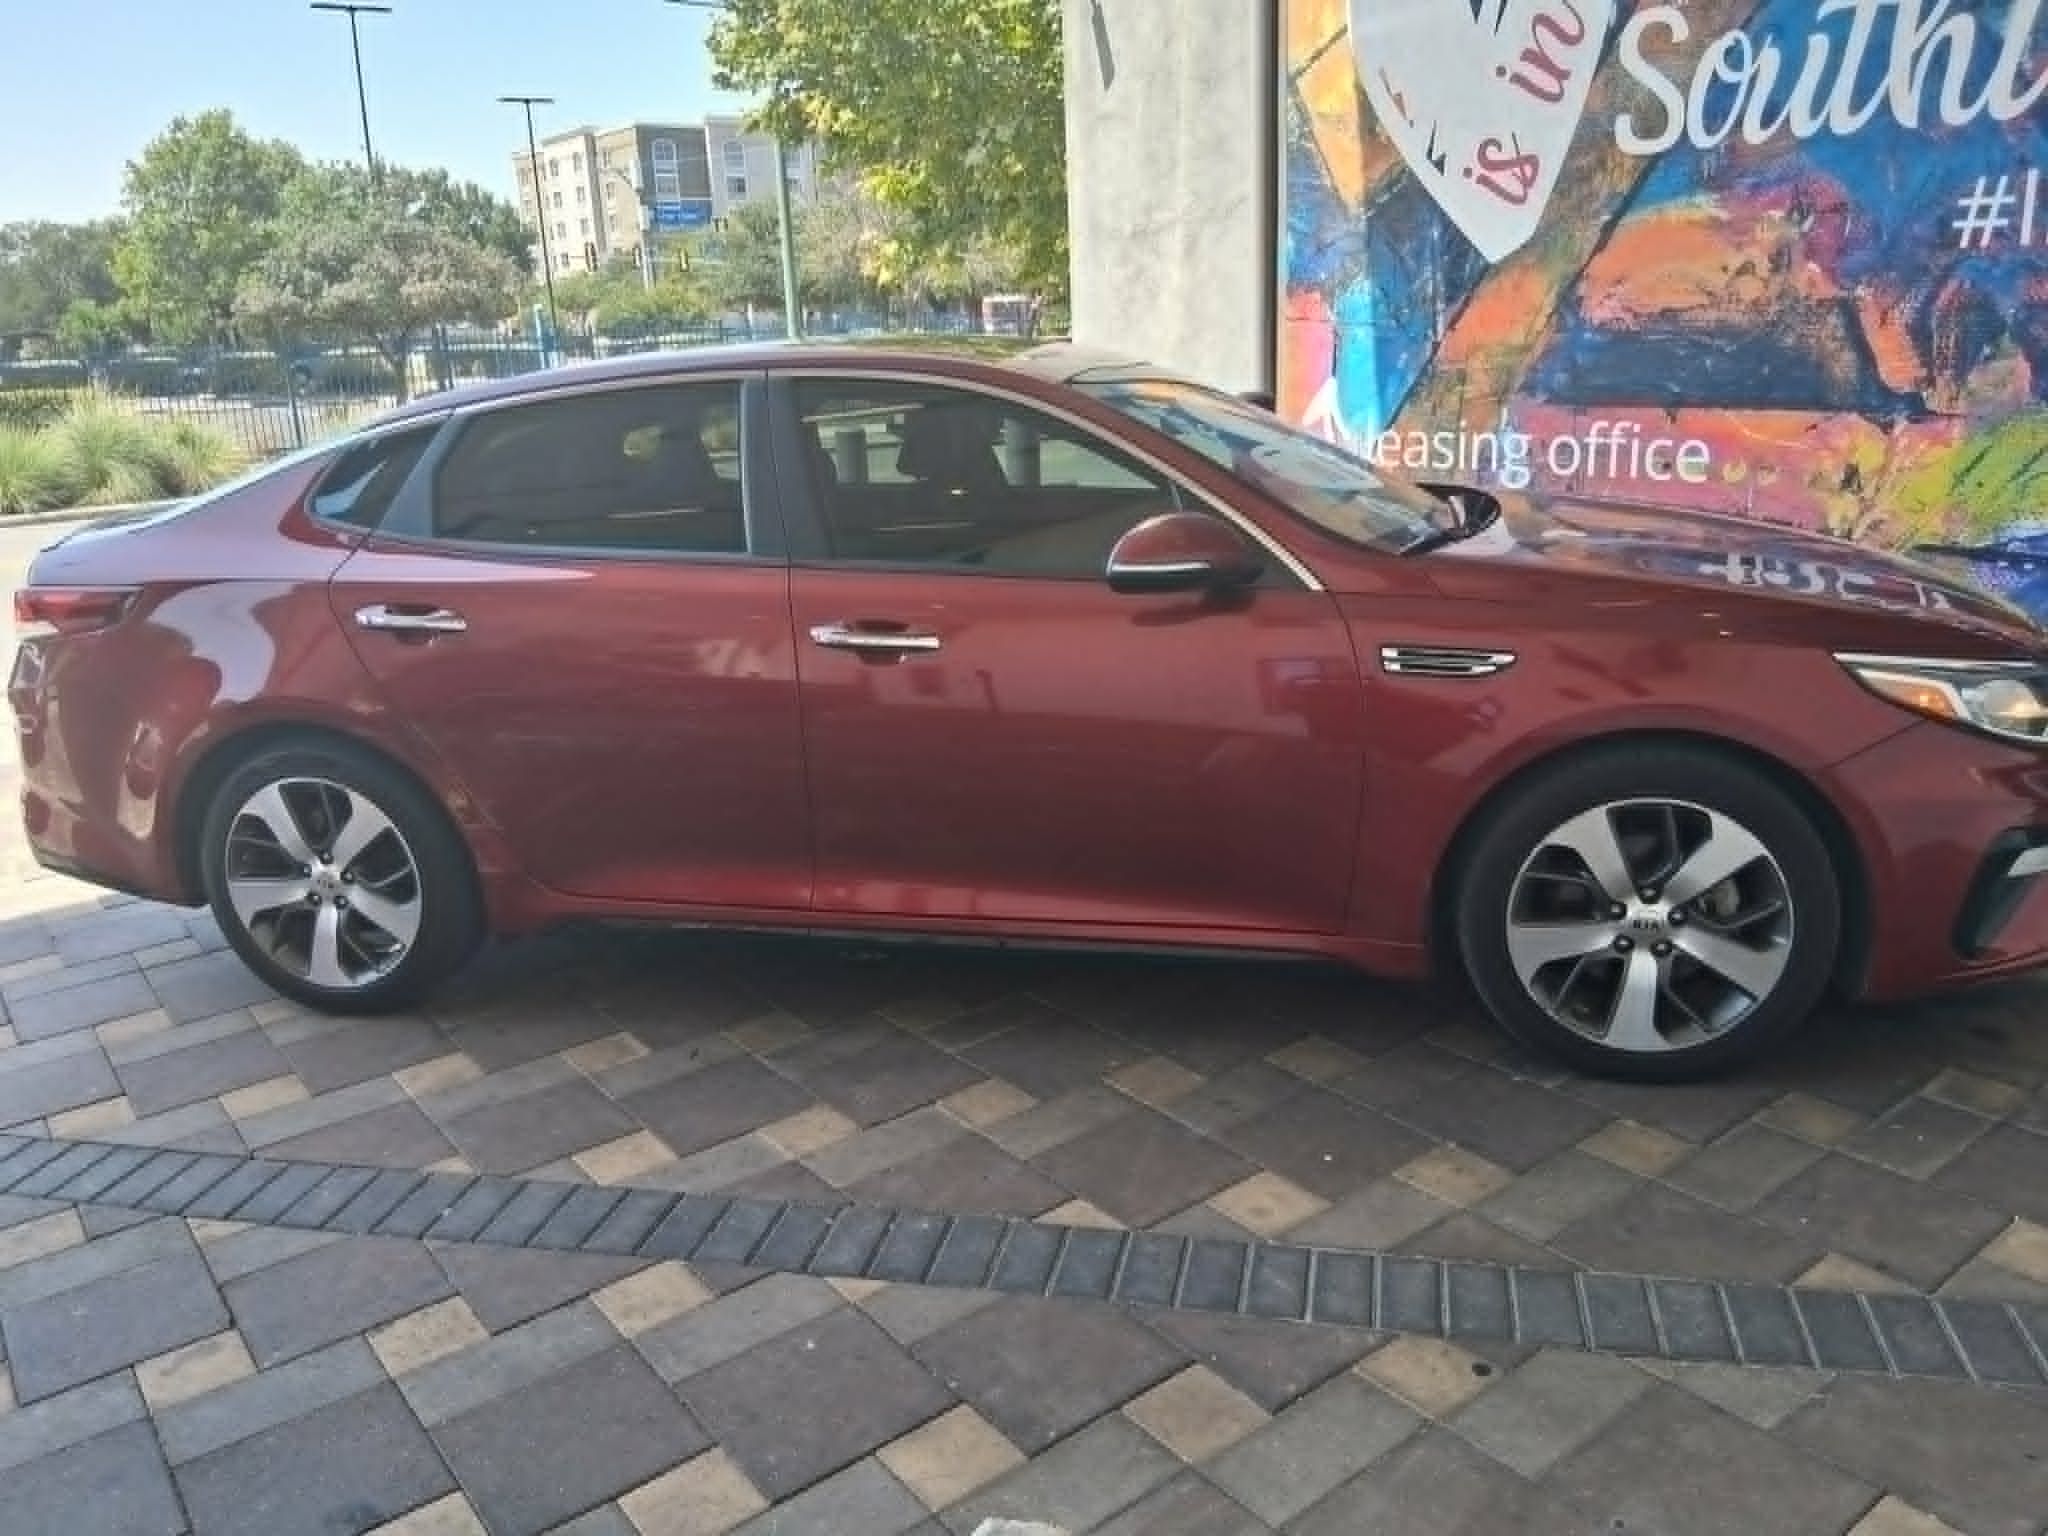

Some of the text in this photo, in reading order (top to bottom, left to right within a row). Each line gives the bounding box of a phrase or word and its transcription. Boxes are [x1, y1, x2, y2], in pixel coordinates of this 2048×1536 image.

[1463, 0, 1585, 205] is in
[1549, 421, 1711, 483] office
